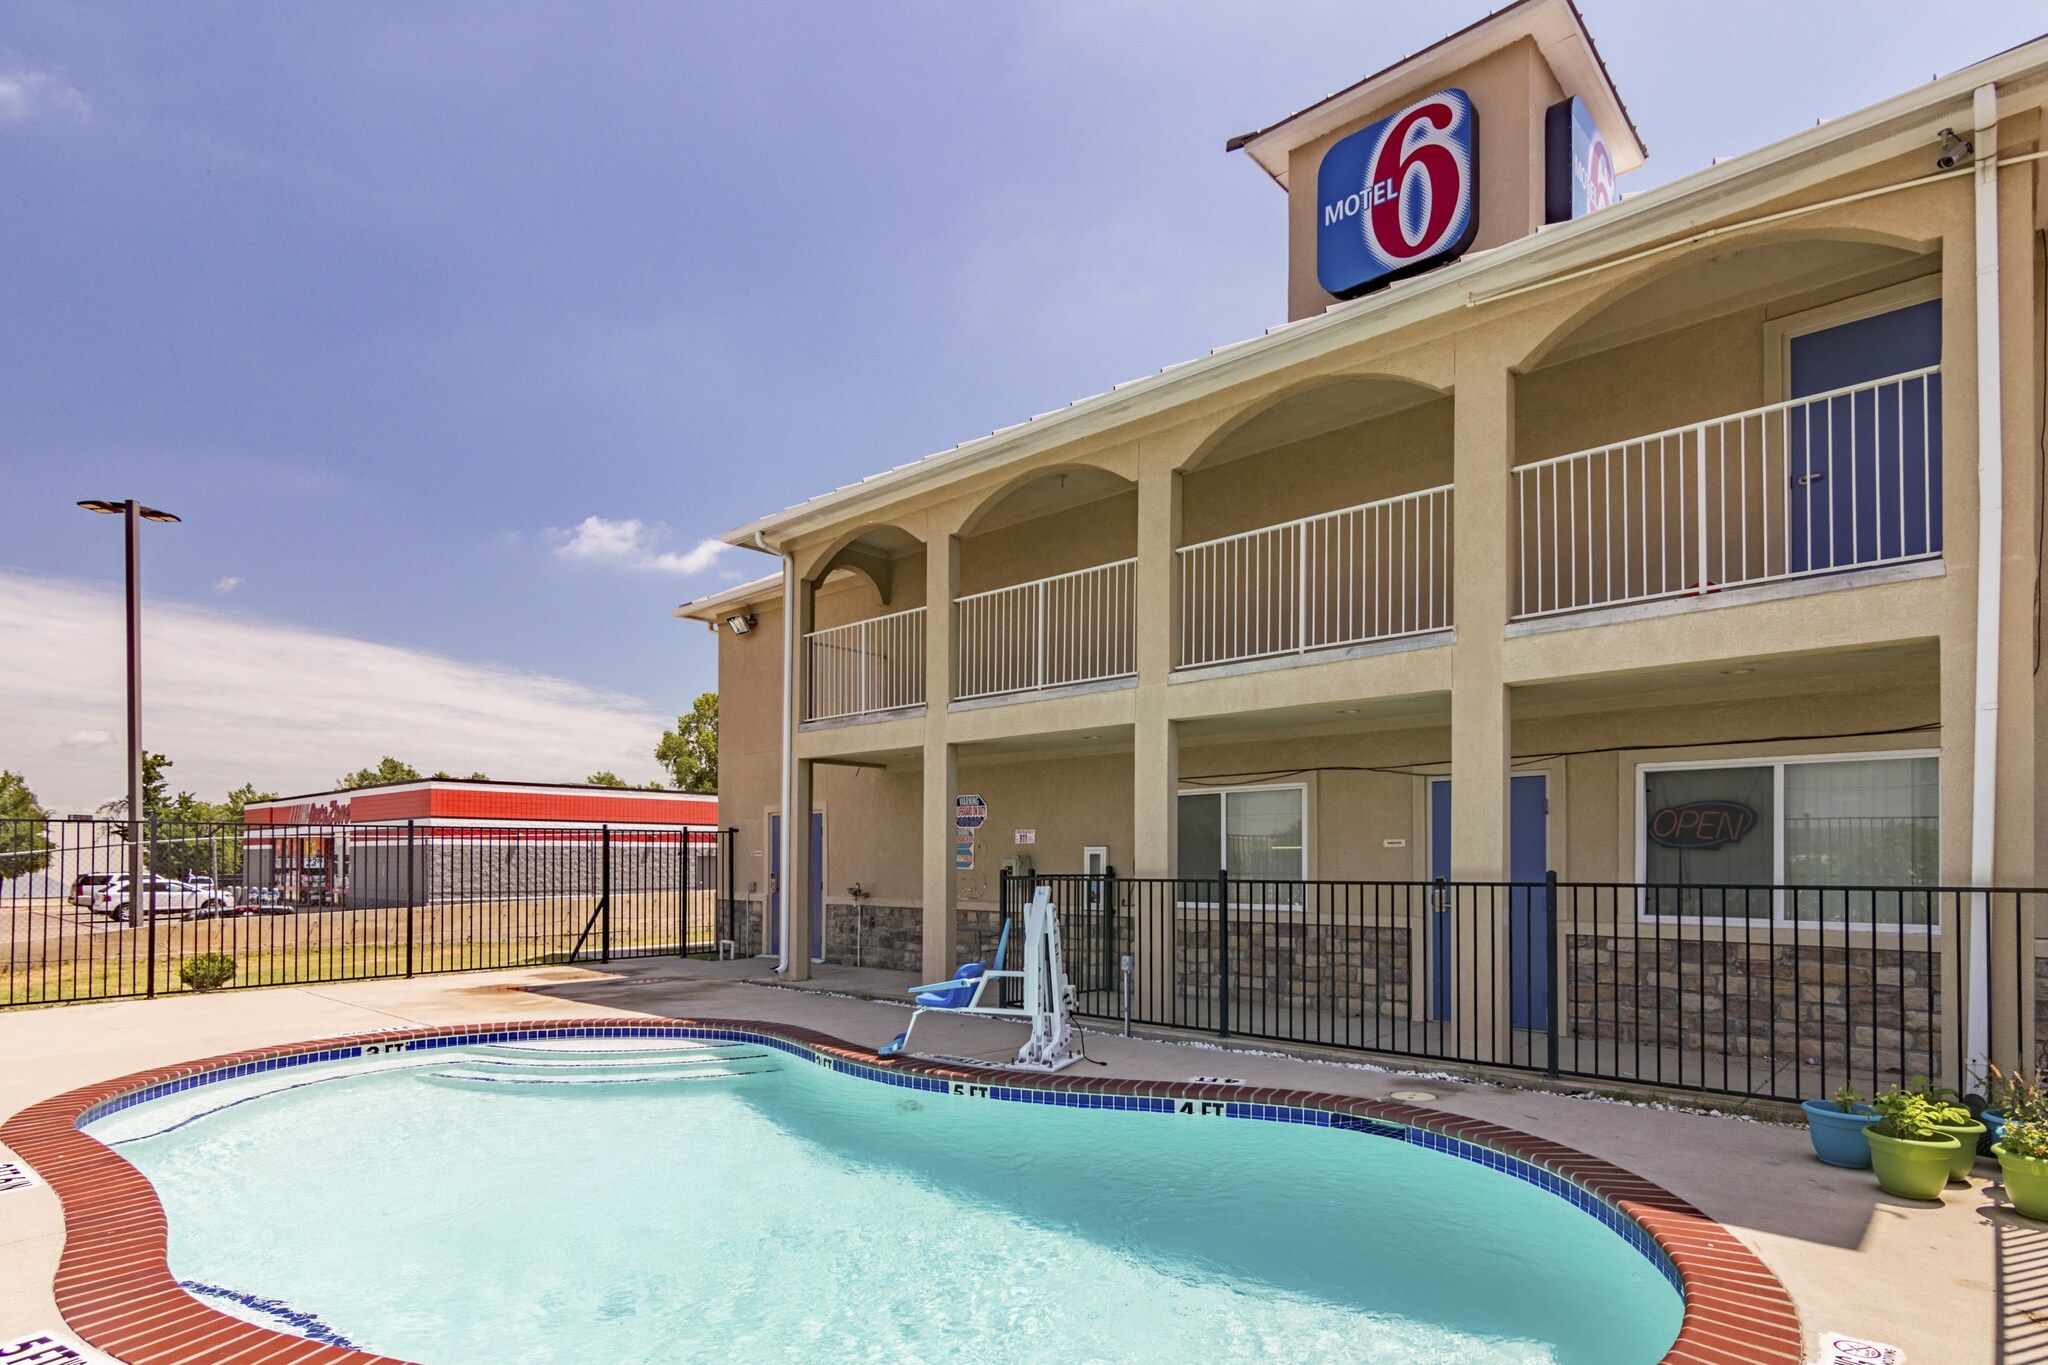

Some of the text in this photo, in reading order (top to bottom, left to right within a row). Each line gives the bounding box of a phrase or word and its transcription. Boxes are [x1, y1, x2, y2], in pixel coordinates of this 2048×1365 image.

[1325, 102, 1460, 259] MOTEL 6
[1652, 808, 1745, 840] OPEN
[970, 1085, 988, 1098] FT
[1179, 1101, 1224, 1116] 4 FT
